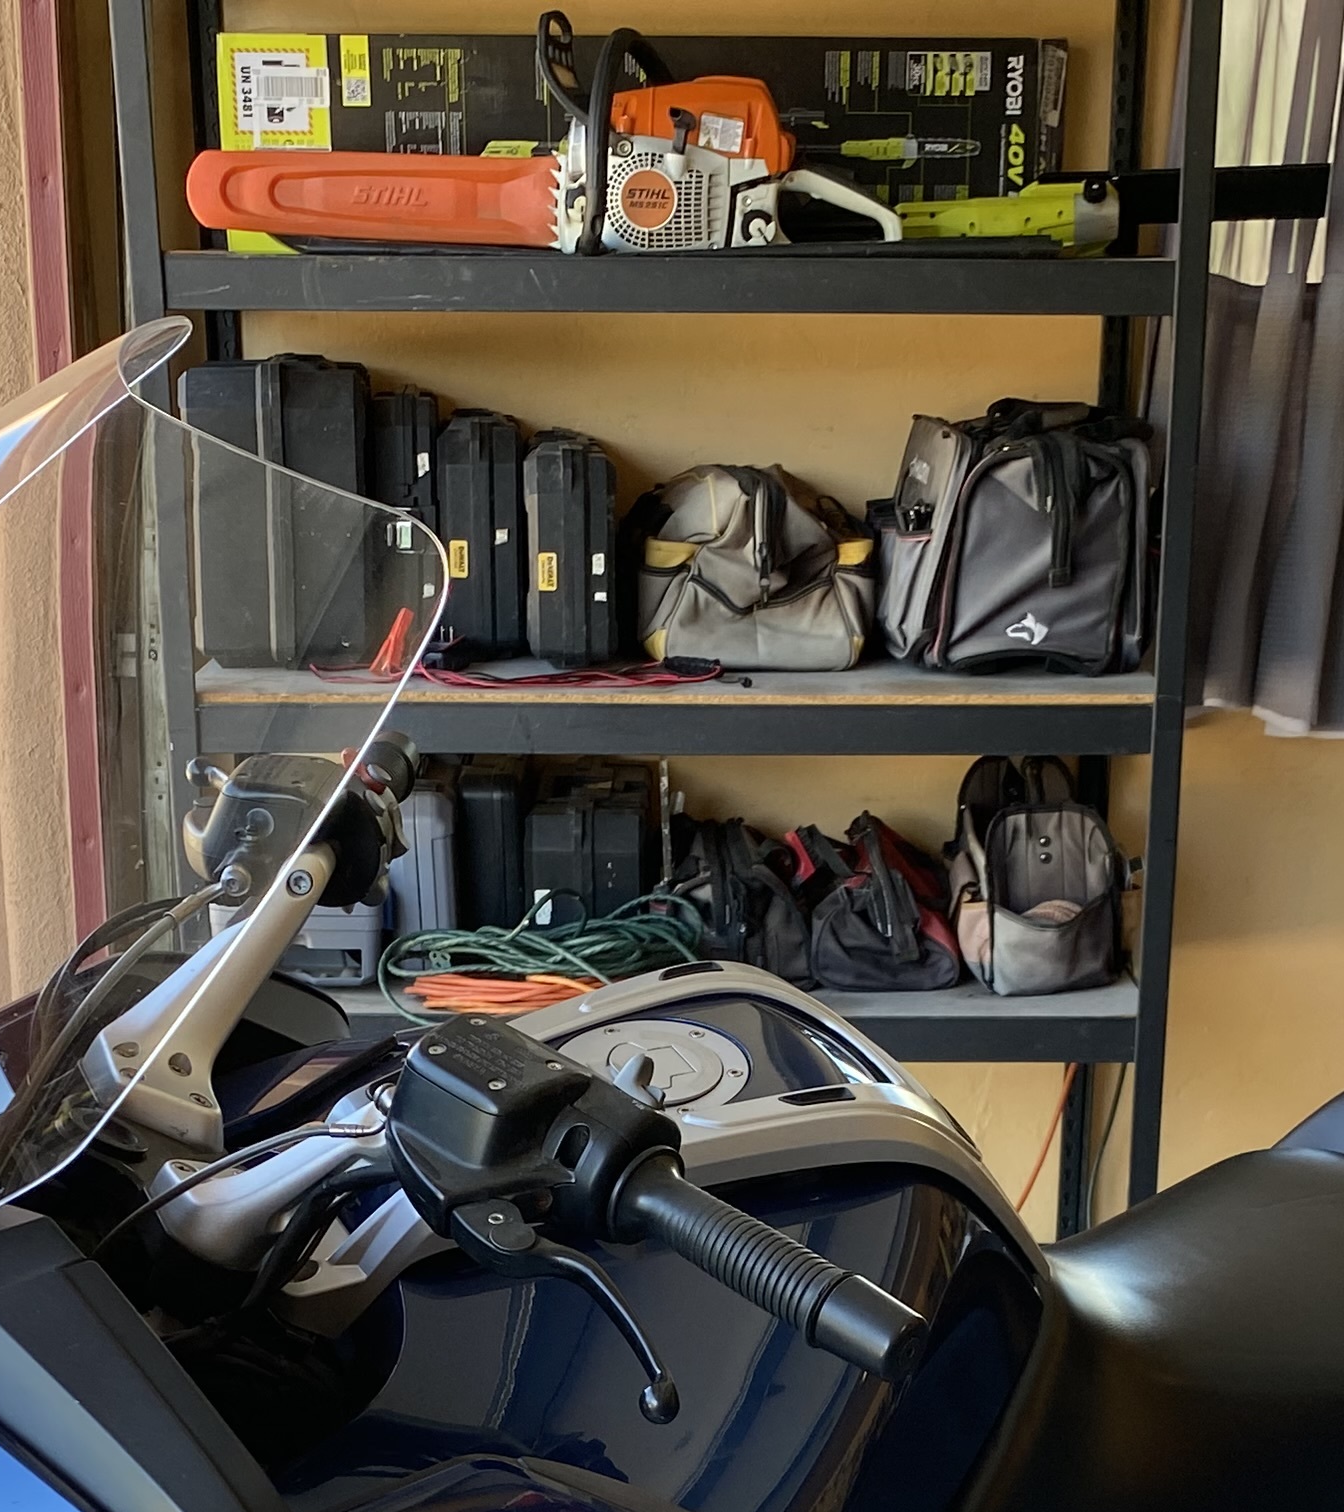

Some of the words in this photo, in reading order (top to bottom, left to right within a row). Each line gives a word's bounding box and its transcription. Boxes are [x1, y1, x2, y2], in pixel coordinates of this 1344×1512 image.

[240, 66, 251, 84] UN
[1005, 55, 1024, 116] RYOBI
[241, 87, 253, 118] 3481
[1008, 123, 1025, 187] 40V
[351, 186, 428, 208] STIHL
[625, 188, 671, 200] STIHL
